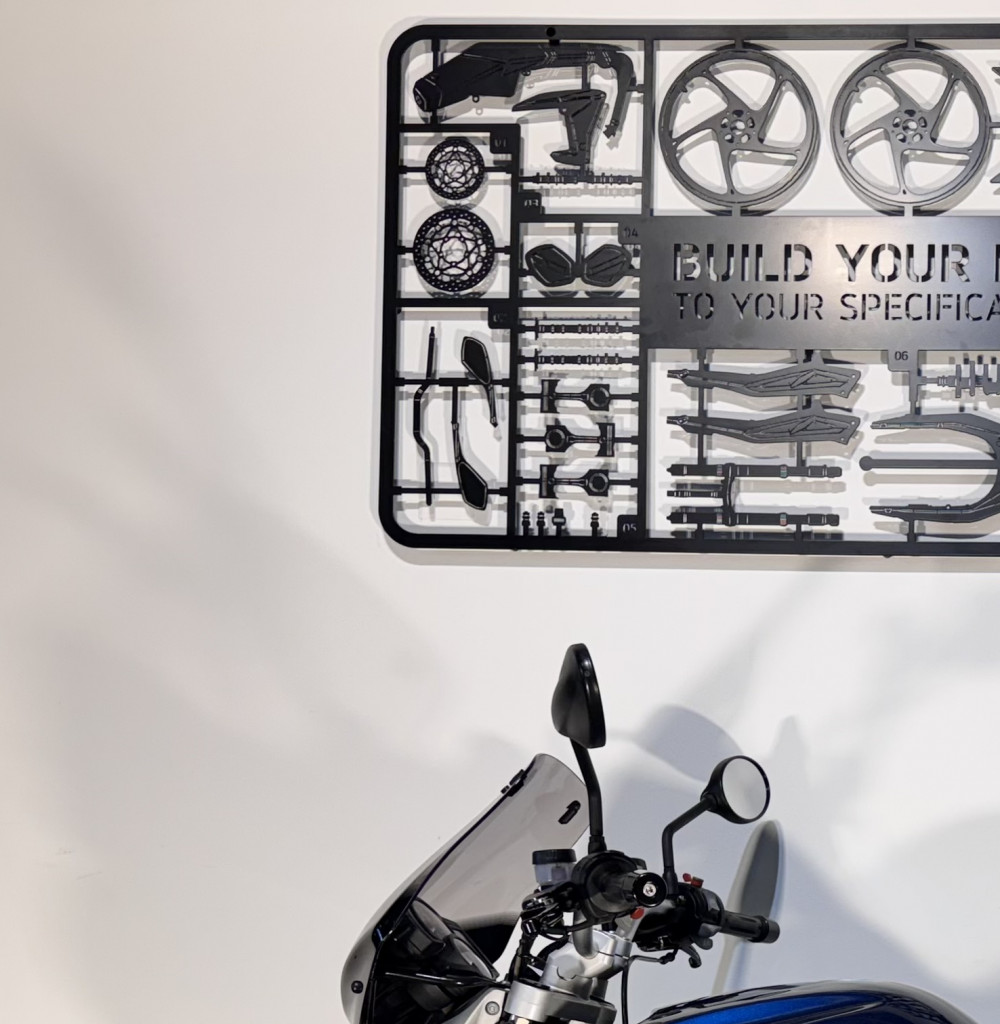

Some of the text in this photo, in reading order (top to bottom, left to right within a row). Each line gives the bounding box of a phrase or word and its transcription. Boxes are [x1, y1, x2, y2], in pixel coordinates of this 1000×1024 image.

[673, 243, 813, 283] BUILD
[836, 243, 971, 283] YOUR
[674, 293, 715, 321] TO
[736, 293, 824, 321] YOUR
[895, 351, 909, 361] 06
[622, 523, 637, 533] 05
